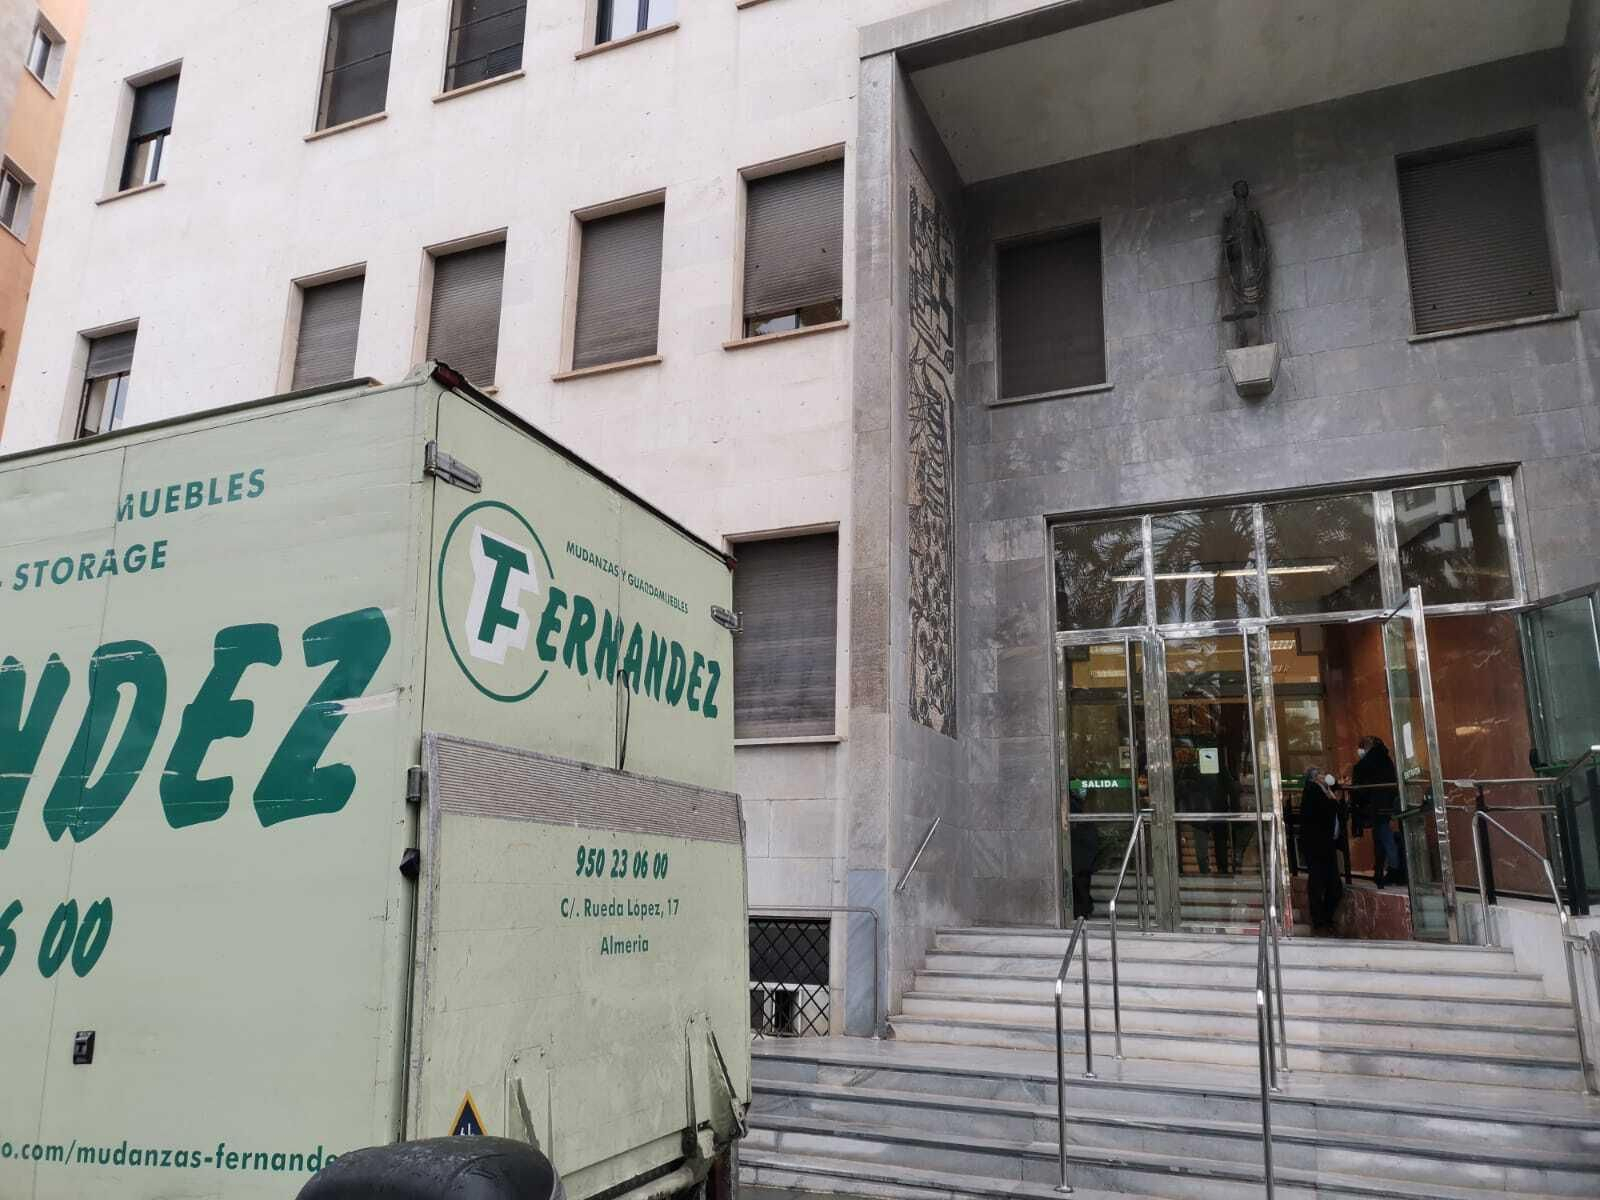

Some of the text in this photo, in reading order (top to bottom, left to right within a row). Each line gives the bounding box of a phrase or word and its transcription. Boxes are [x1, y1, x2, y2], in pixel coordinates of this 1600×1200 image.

[13, 540, 168, 591] STORAGE
[566, 541, 619, 577] MUDANZAS
[620, 567, 626, 581] Y
[1081, 780, 1118, 788] SALIDA
[576, 845, 668, 880] 950 23 06 00
[560, 898, 579, 919] C/.
[584, 897, 623, 917] Rueda
[667, 899, 679, 916] 17
[38, 897, 113, 978] 00
